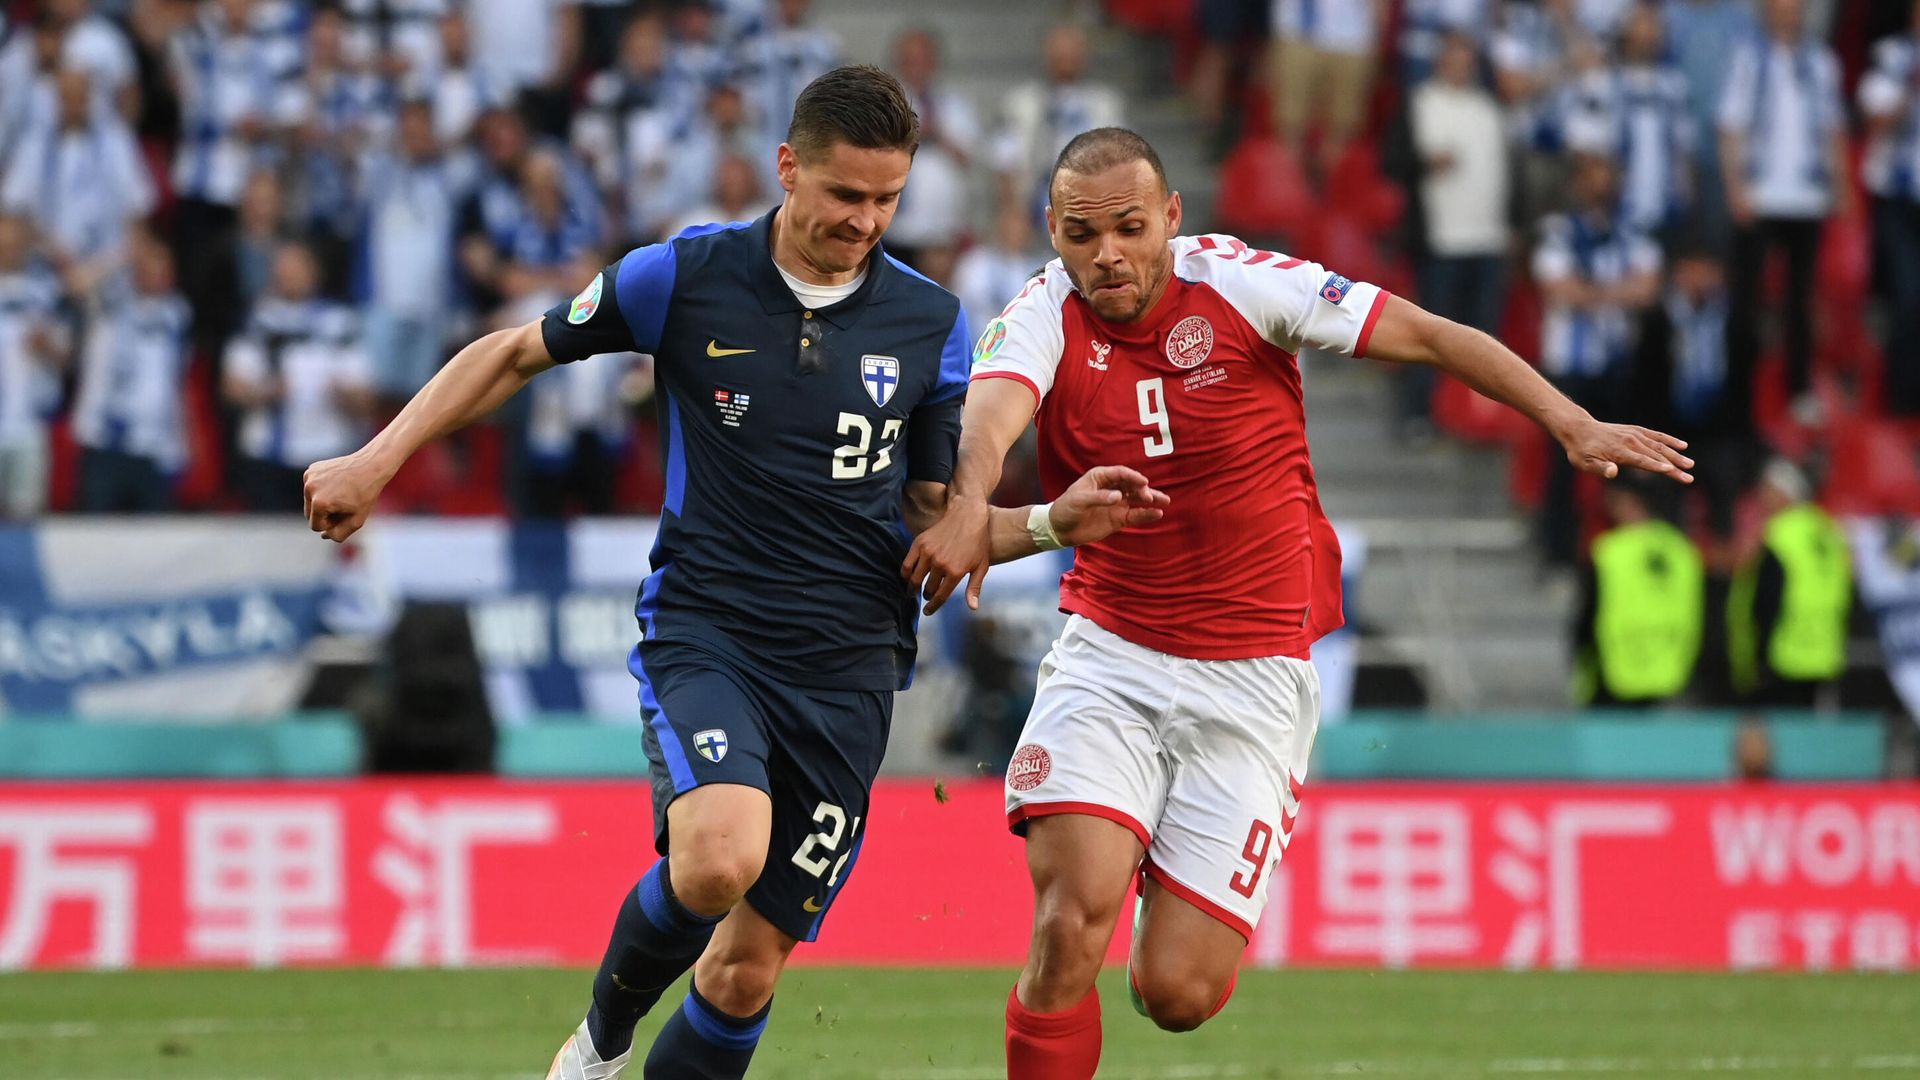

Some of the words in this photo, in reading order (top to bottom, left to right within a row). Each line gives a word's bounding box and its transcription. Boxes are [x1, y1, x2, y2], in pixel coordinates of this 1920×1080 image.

[1177, 329, 1204, 353] DBU
[1136, 377, 1174, 457] 9
[1015, 759, 1041, 776] DBU
[0, 797, 558, 968] 万里汇
[1229, 819, 1272, 899] 9
